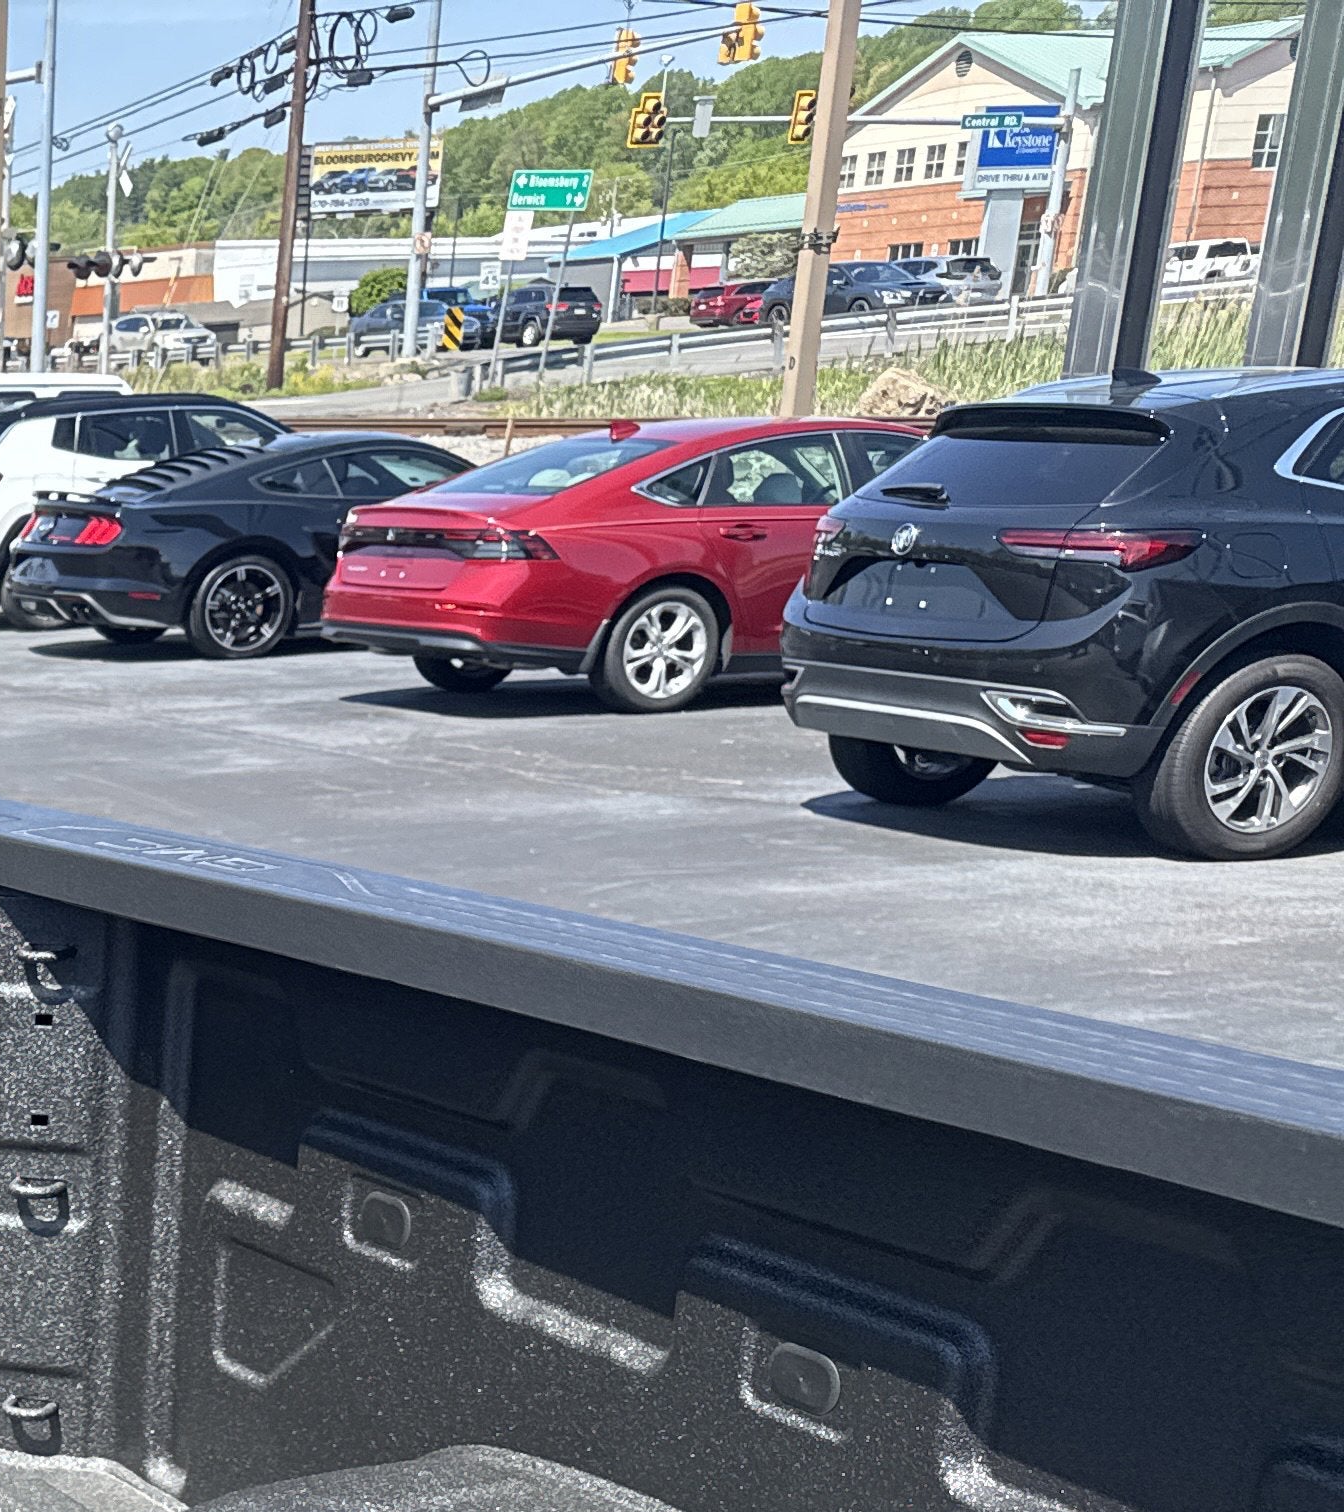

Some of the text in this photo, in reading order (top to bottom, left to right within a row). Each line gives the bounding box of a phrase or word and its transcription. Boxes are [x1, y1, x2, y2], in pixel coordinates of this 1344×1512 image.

[965, 117, 999, 126] Central
[314, 151, 439, 165] BLOOMSBURGCHEVY.M
[529, 175, 579, 189] Bloomsburg
[512, 193, 546, 205] Berwick
[482, 275, 497, 285] 45
